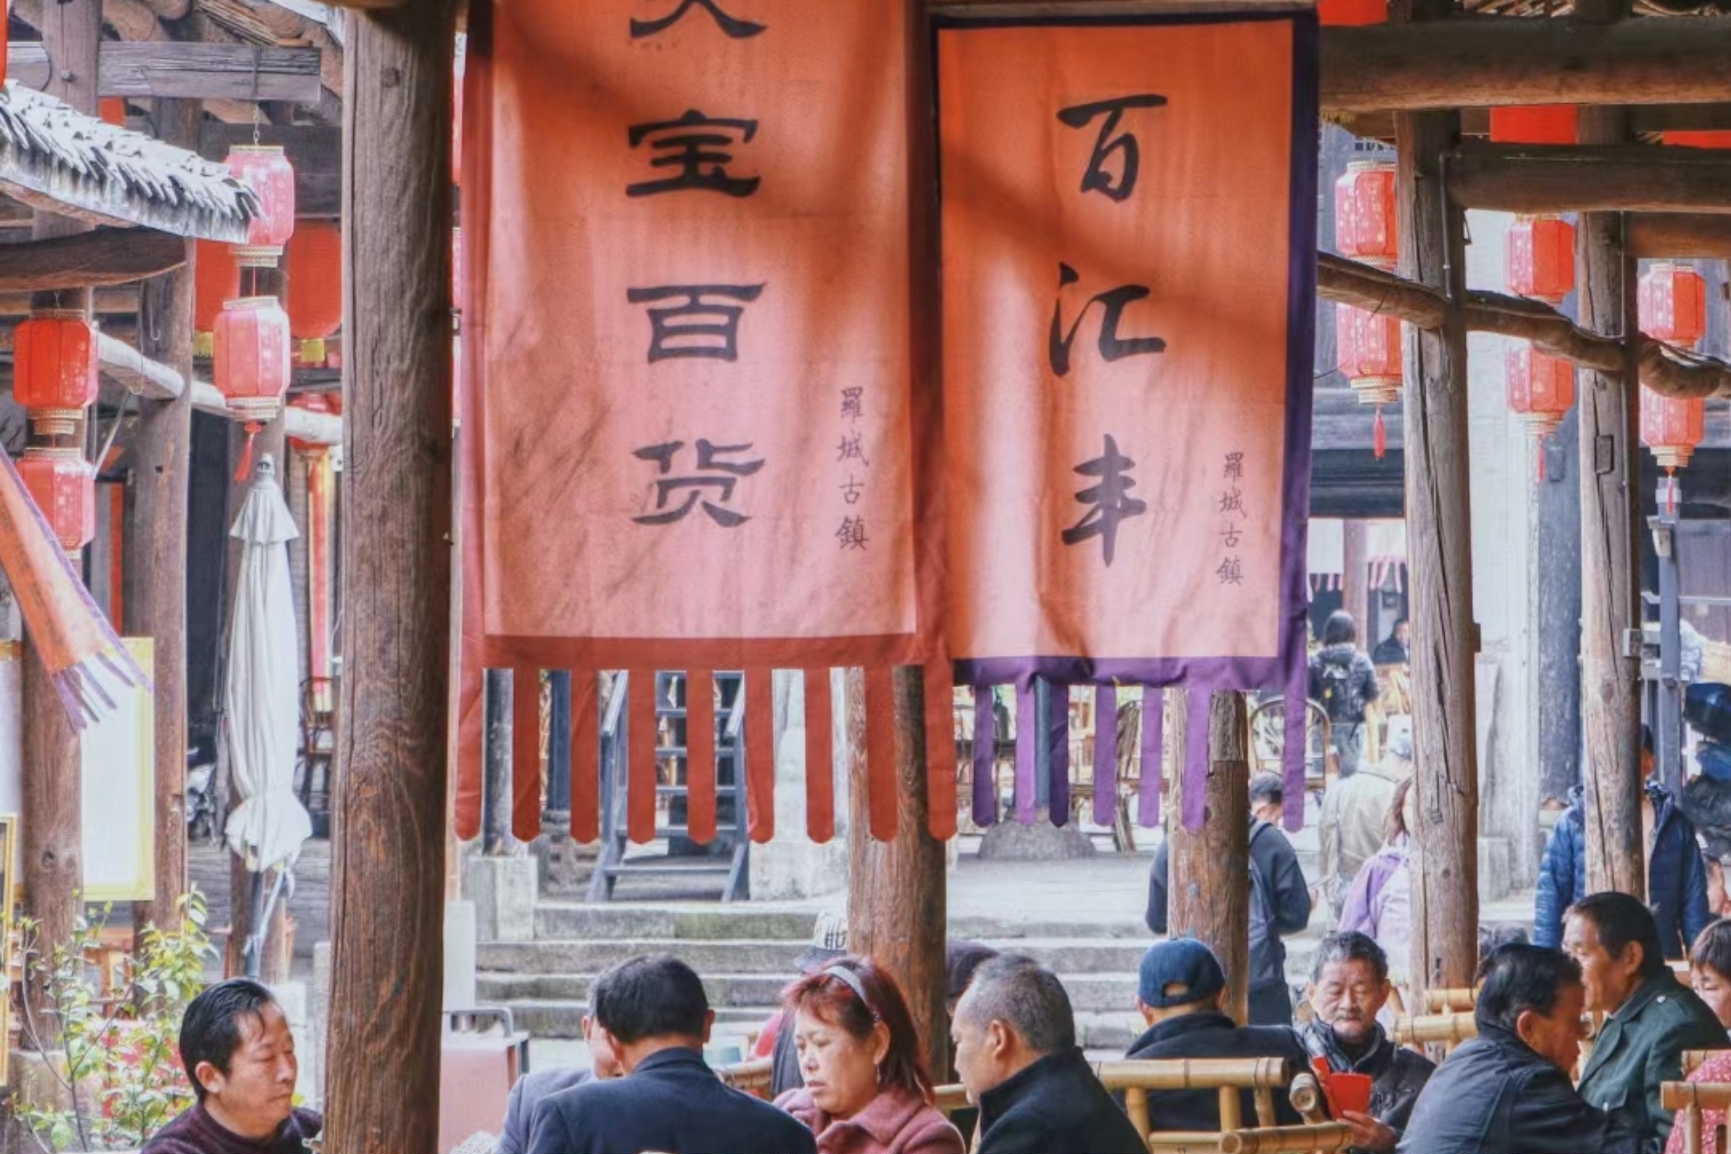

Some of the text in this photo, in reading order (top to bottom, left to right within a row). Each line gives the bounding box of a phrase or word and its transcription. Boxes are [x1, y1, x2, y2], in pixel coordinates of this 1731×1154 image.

[834, 386, 870, 551] 羅城古鎮
[1216, 451, 1247, 586] 羅城古鎮
